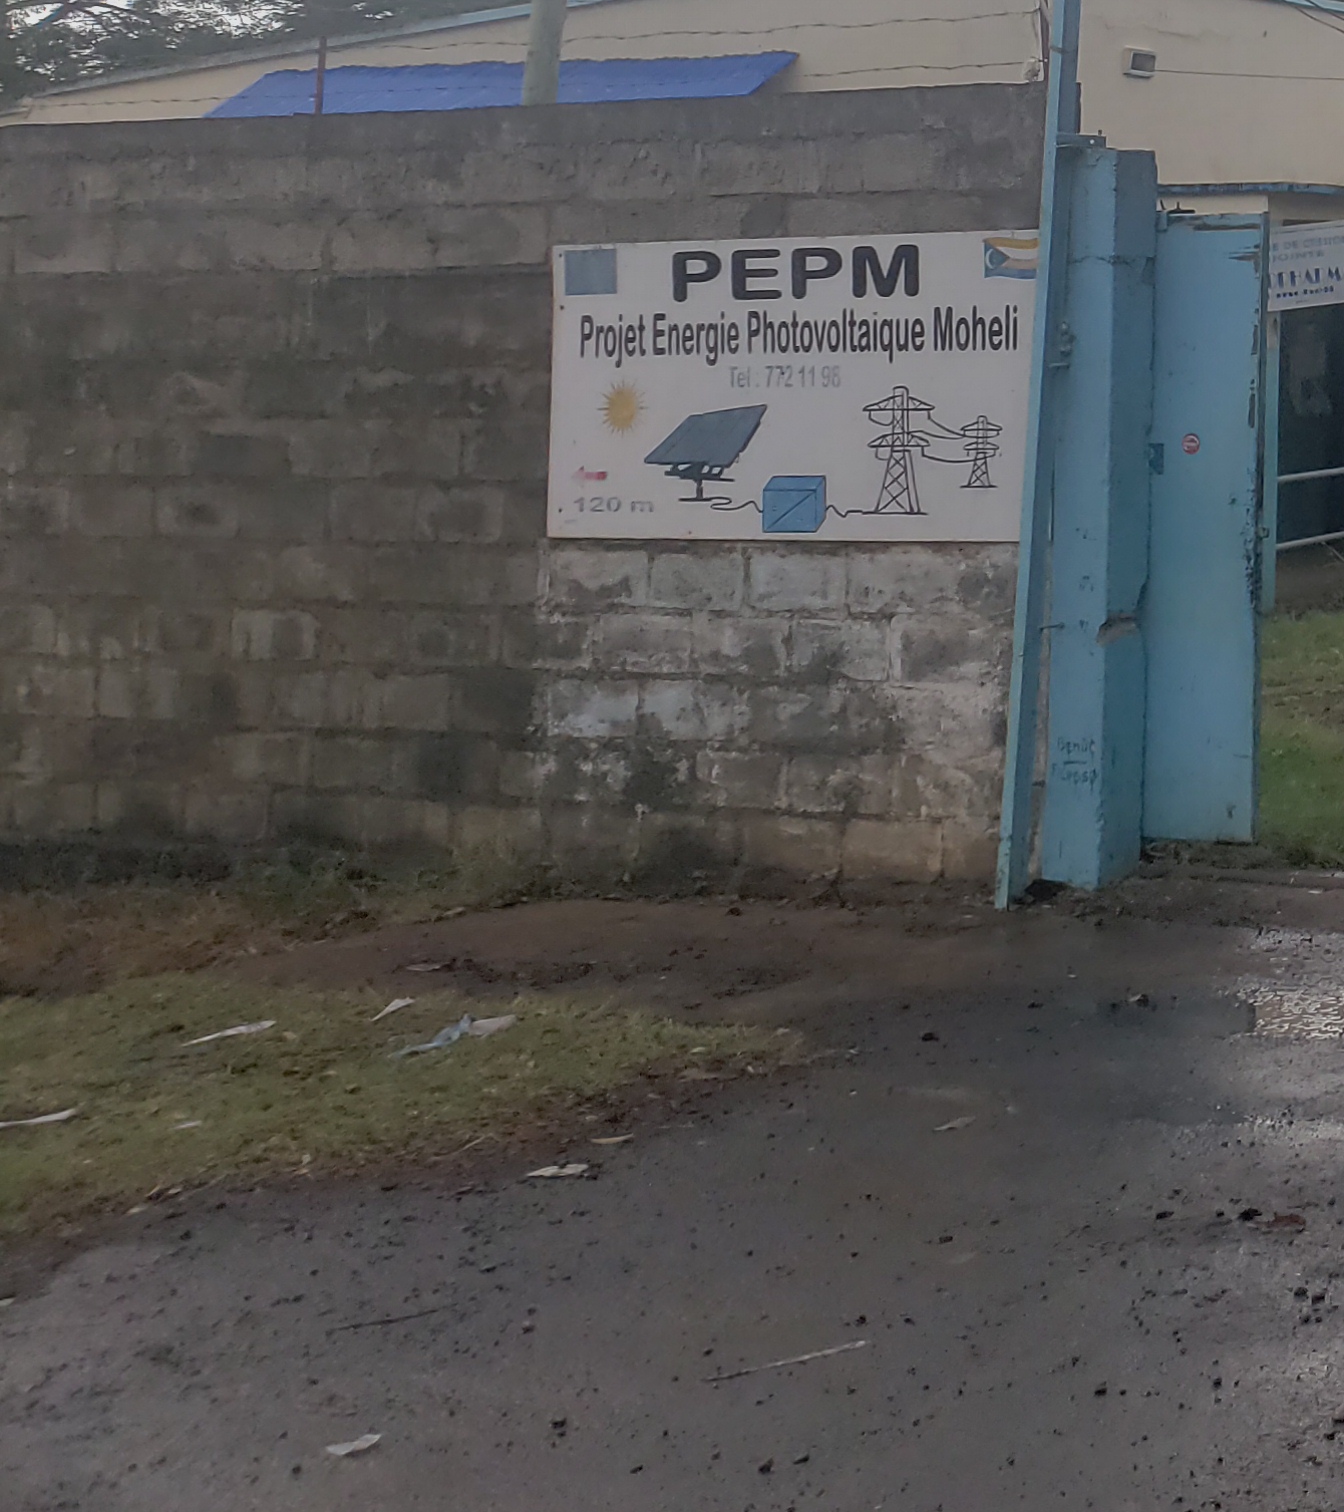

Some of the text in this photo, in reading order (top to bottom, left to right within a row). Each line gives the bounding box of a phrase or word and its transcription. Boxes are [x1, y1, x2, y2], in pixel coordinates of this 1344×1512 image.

[672, 244, 920, 302] PEPM
[580, 311, 646, 368] Projet
[652, 310, 739, 366] Energie
[933, 304, 1018, 353] Moheli
[764, 365, 794, 388] 772
[573, 496, 622, 513] 120
